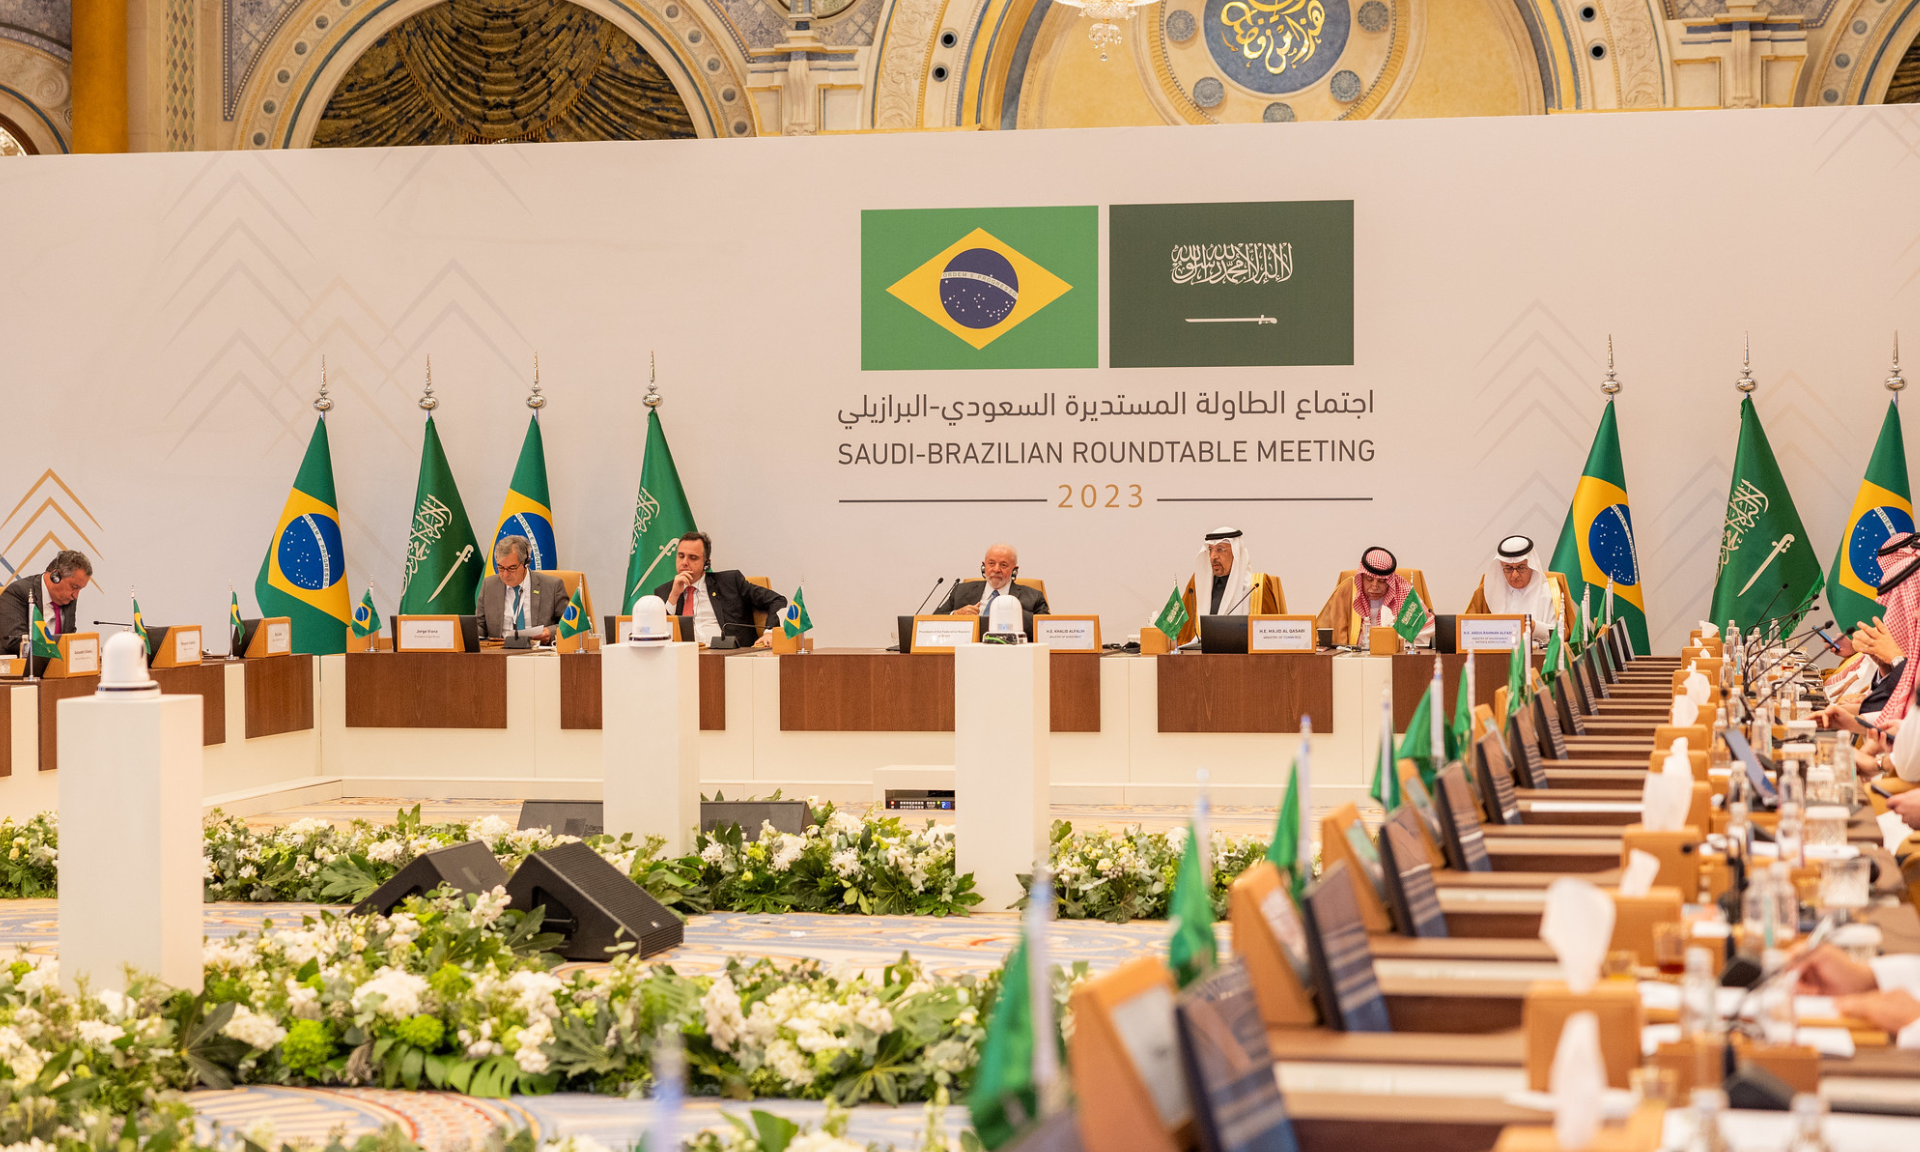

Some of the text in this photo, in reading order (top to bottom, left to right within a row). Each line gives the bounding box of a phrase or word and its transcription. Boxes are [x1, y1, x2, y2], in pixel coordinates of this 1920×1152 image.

[837, 389, 1374, 430] اجتماع الطاولة المستديرة السعودي-البرازيلي
[838, 439, 1375, 466] SAUDI-BRAZILIAN ROUNDTABLE MEETING
[1057, 483, 1143, 509] 2023
